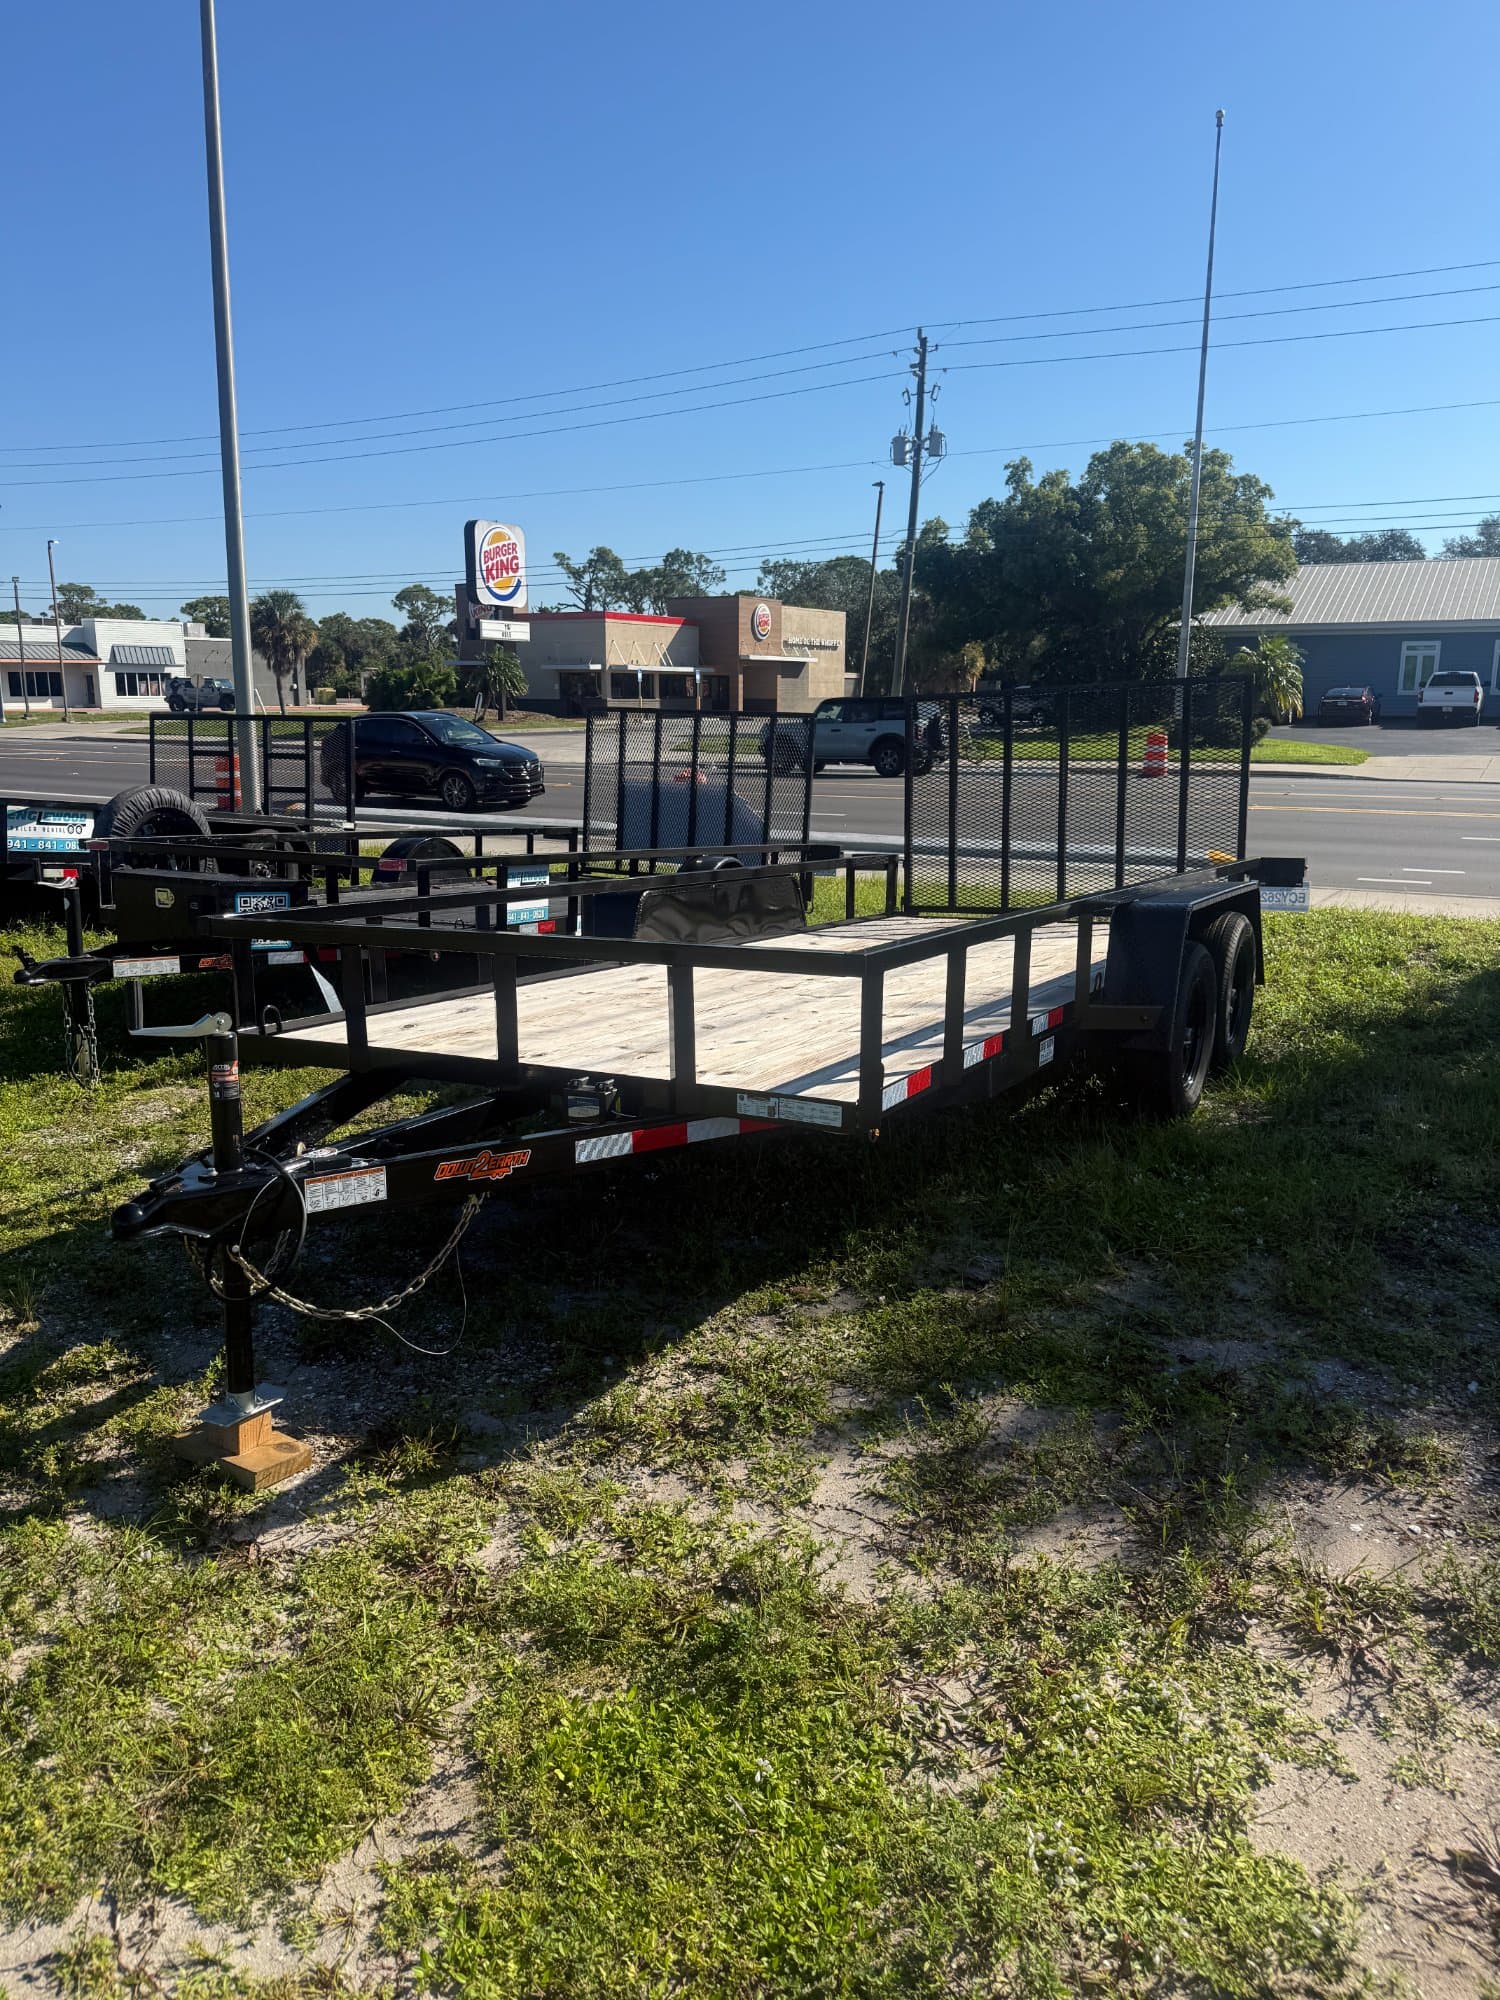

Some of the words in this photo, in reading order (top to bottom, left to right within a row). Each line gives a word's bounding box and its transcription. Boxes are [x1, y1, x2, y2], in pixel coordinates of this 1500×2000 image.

[483, 542, 518, 565] BURGER
[485, 555, 520, 584] KING
[788, 635, 802, 645] HOME
[7, 809, 88, 825] ENGLEWOOD
[435, 1151, 529, 1179] DOWN2EARTH
